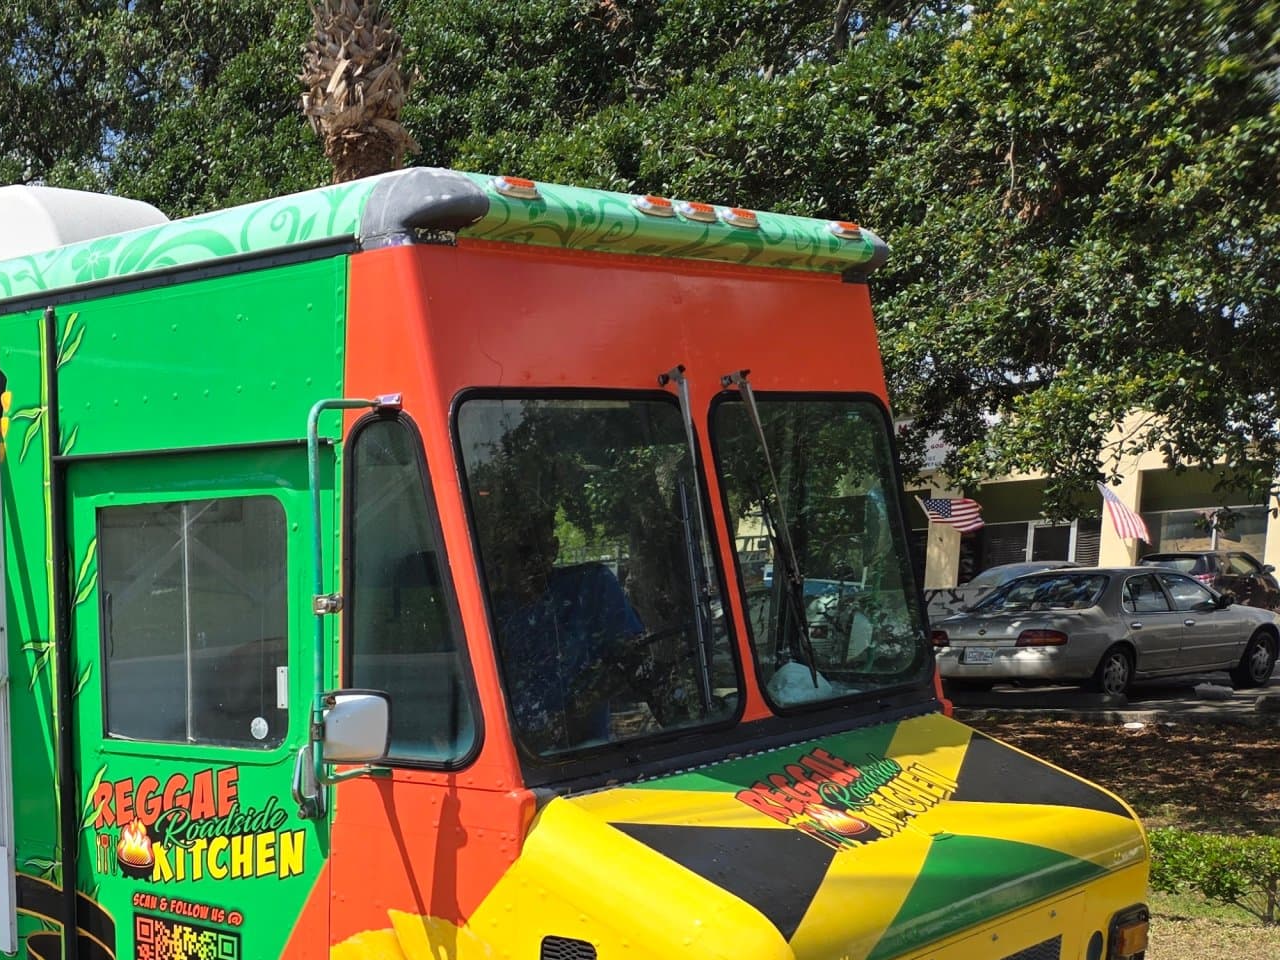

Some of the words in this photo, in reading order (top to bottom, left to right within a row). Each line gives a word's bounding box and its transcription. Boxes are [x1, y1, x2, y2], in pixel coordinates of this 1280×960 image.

[93, 766, 239, 830] REGGAE
[153, 796, 288, 850] Roadside
[151, 829, 306, 884] KITCHEN
[133, 892, 158, 909] SCAN
[159, 897, 168, 911] &
[170, 899, 209, 921] FOLLOW
[211, 908, 225, 924] US
[227, 911, 243, 927] @
